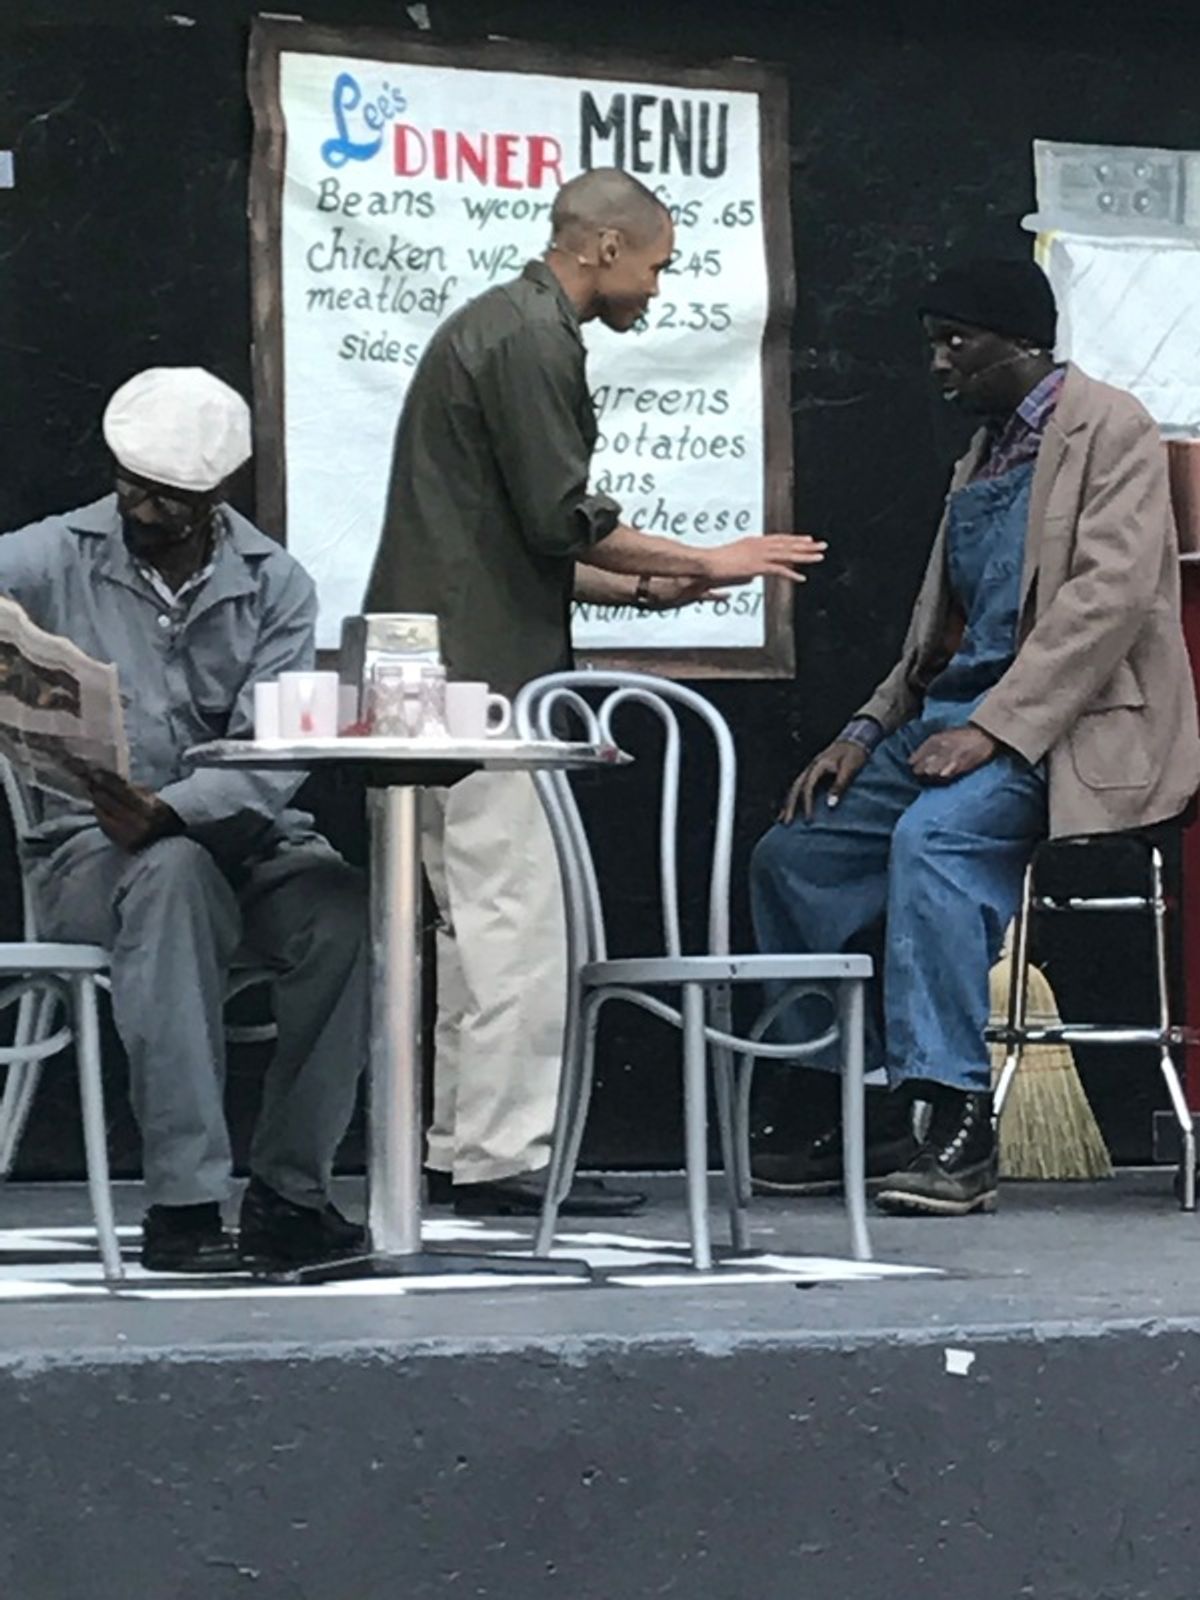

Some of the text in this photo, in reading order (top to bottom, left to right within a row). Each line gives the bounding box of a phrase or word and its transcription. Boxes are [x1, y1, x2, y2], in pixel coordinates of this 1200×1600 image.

[321, 73, 563, 189] Lee's DINER
[579, 91, 730, 178] MENU
[316, 177, 436, 218] Beans
[462, 197, 556, 230] w/cor
[713, 200, 755, 228] .65
[306, 275, 458, 317] meatloaf
[338, 329, 419, 366] sides
[591, 385, 729, 420] greens
[594, 469, 656, 494] ans
[631, 498, 750, 535] cheese
